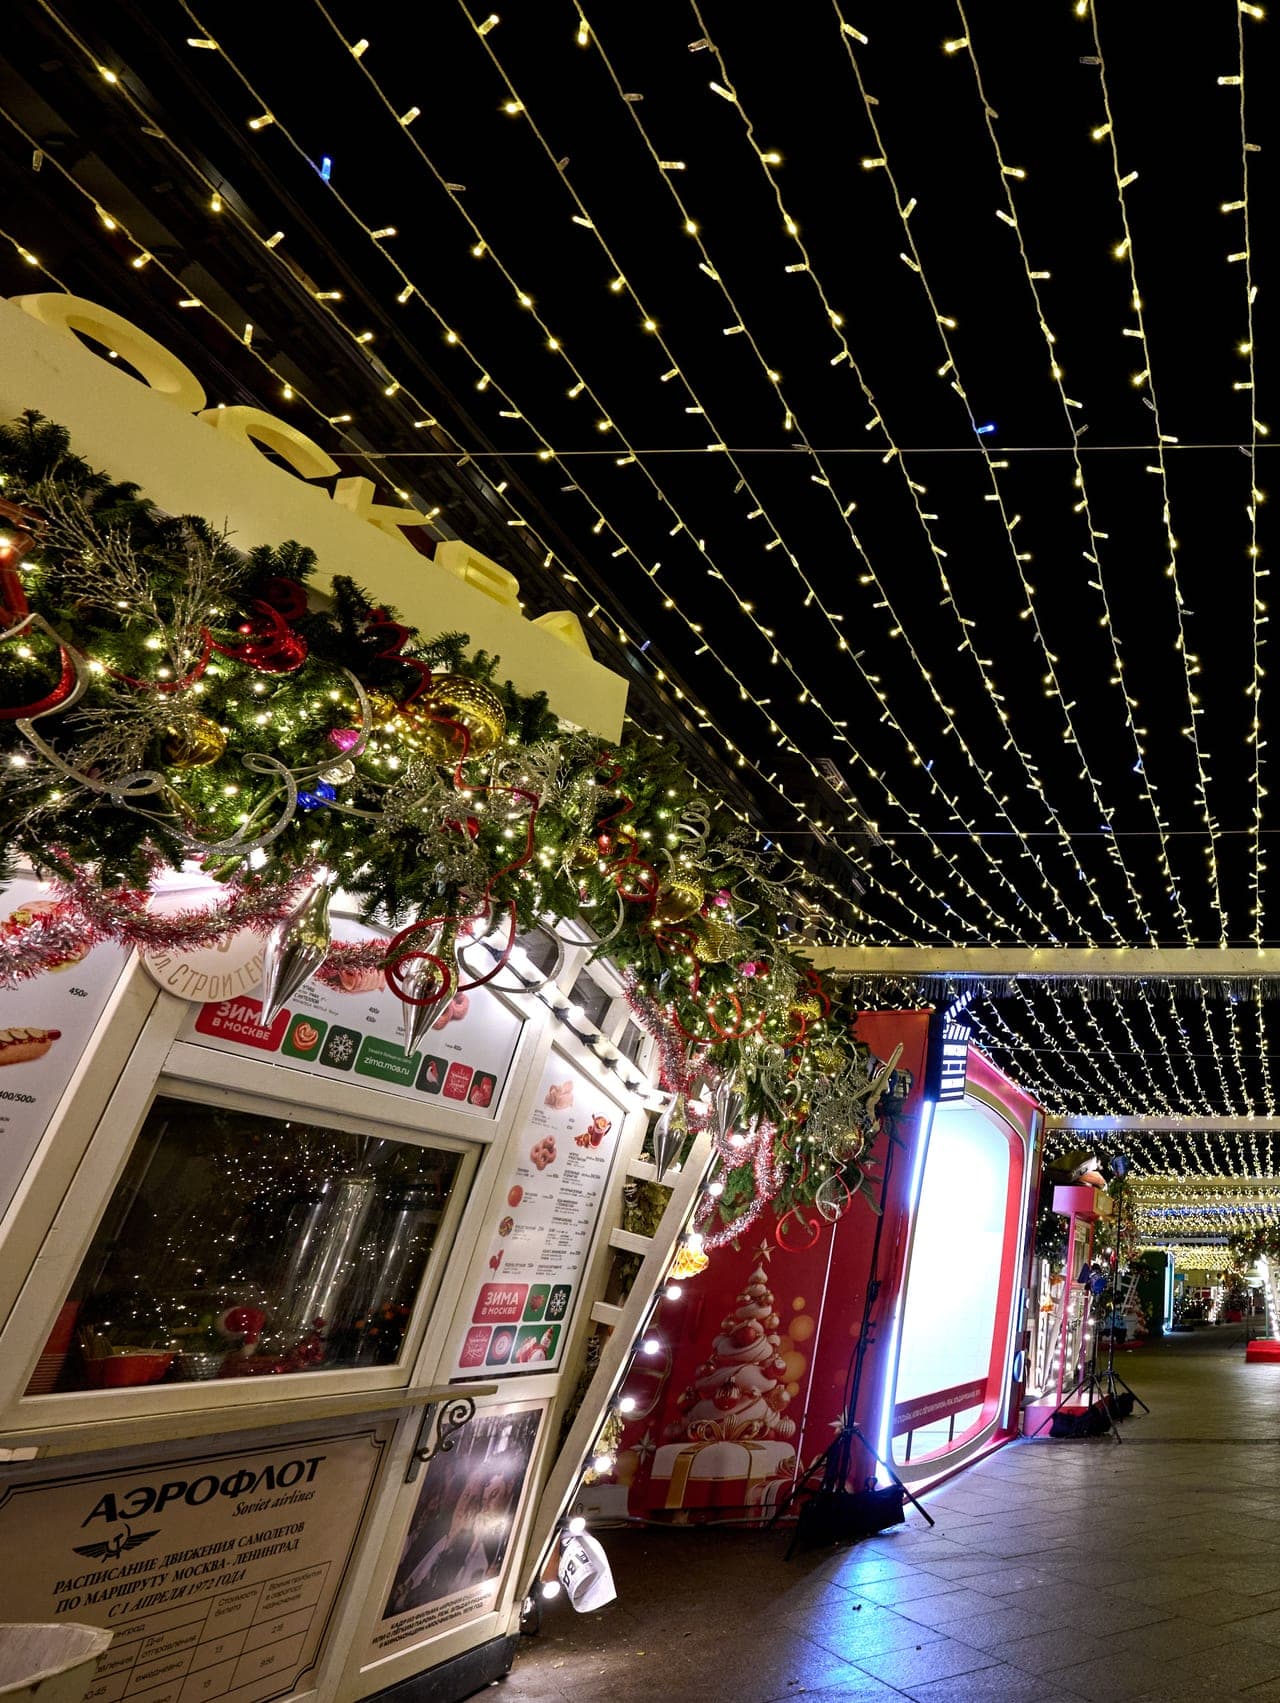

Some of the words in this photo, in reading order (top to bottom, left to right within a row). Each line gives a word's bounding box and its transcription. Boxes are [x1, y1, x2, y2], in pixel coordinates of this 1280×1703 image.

[152, 953, 171, 972] ул.
[212, 1019, 220, 1027] В
[223, 1021, 271, 1041] МОСКВЕ
[364, 1056, 411, 1076] zima.mos.ru
[485, 1292, 519, 1305] ЗИМА
[488, 1306, 516, 1315] МОСКВЕ
[81, 1456, 326, 1528] АЭРОФЛОТ
[232, 1500, 271, 1517] Soviet
[271, 1489, 315, 1510] airlines
[53, 1558, 158, 1595] РАСПИСАНИЕ
[159, 1539, 236, 1569] ДВИЖЕНИЯ
[238, 1521, 305, 1547] САМОЛЕТОВ
[55, 1599, 80, 1615] ПО
[83, 1573, 168, 1607] МАРШРУТУ
[107, 1605, 121, 1618] С
[130, 1589, 187, 1612] АПРЕЛЯ
[188, 1581, 215, 1598] 1972
[213, 1569, 247, 1592] ГОДА
